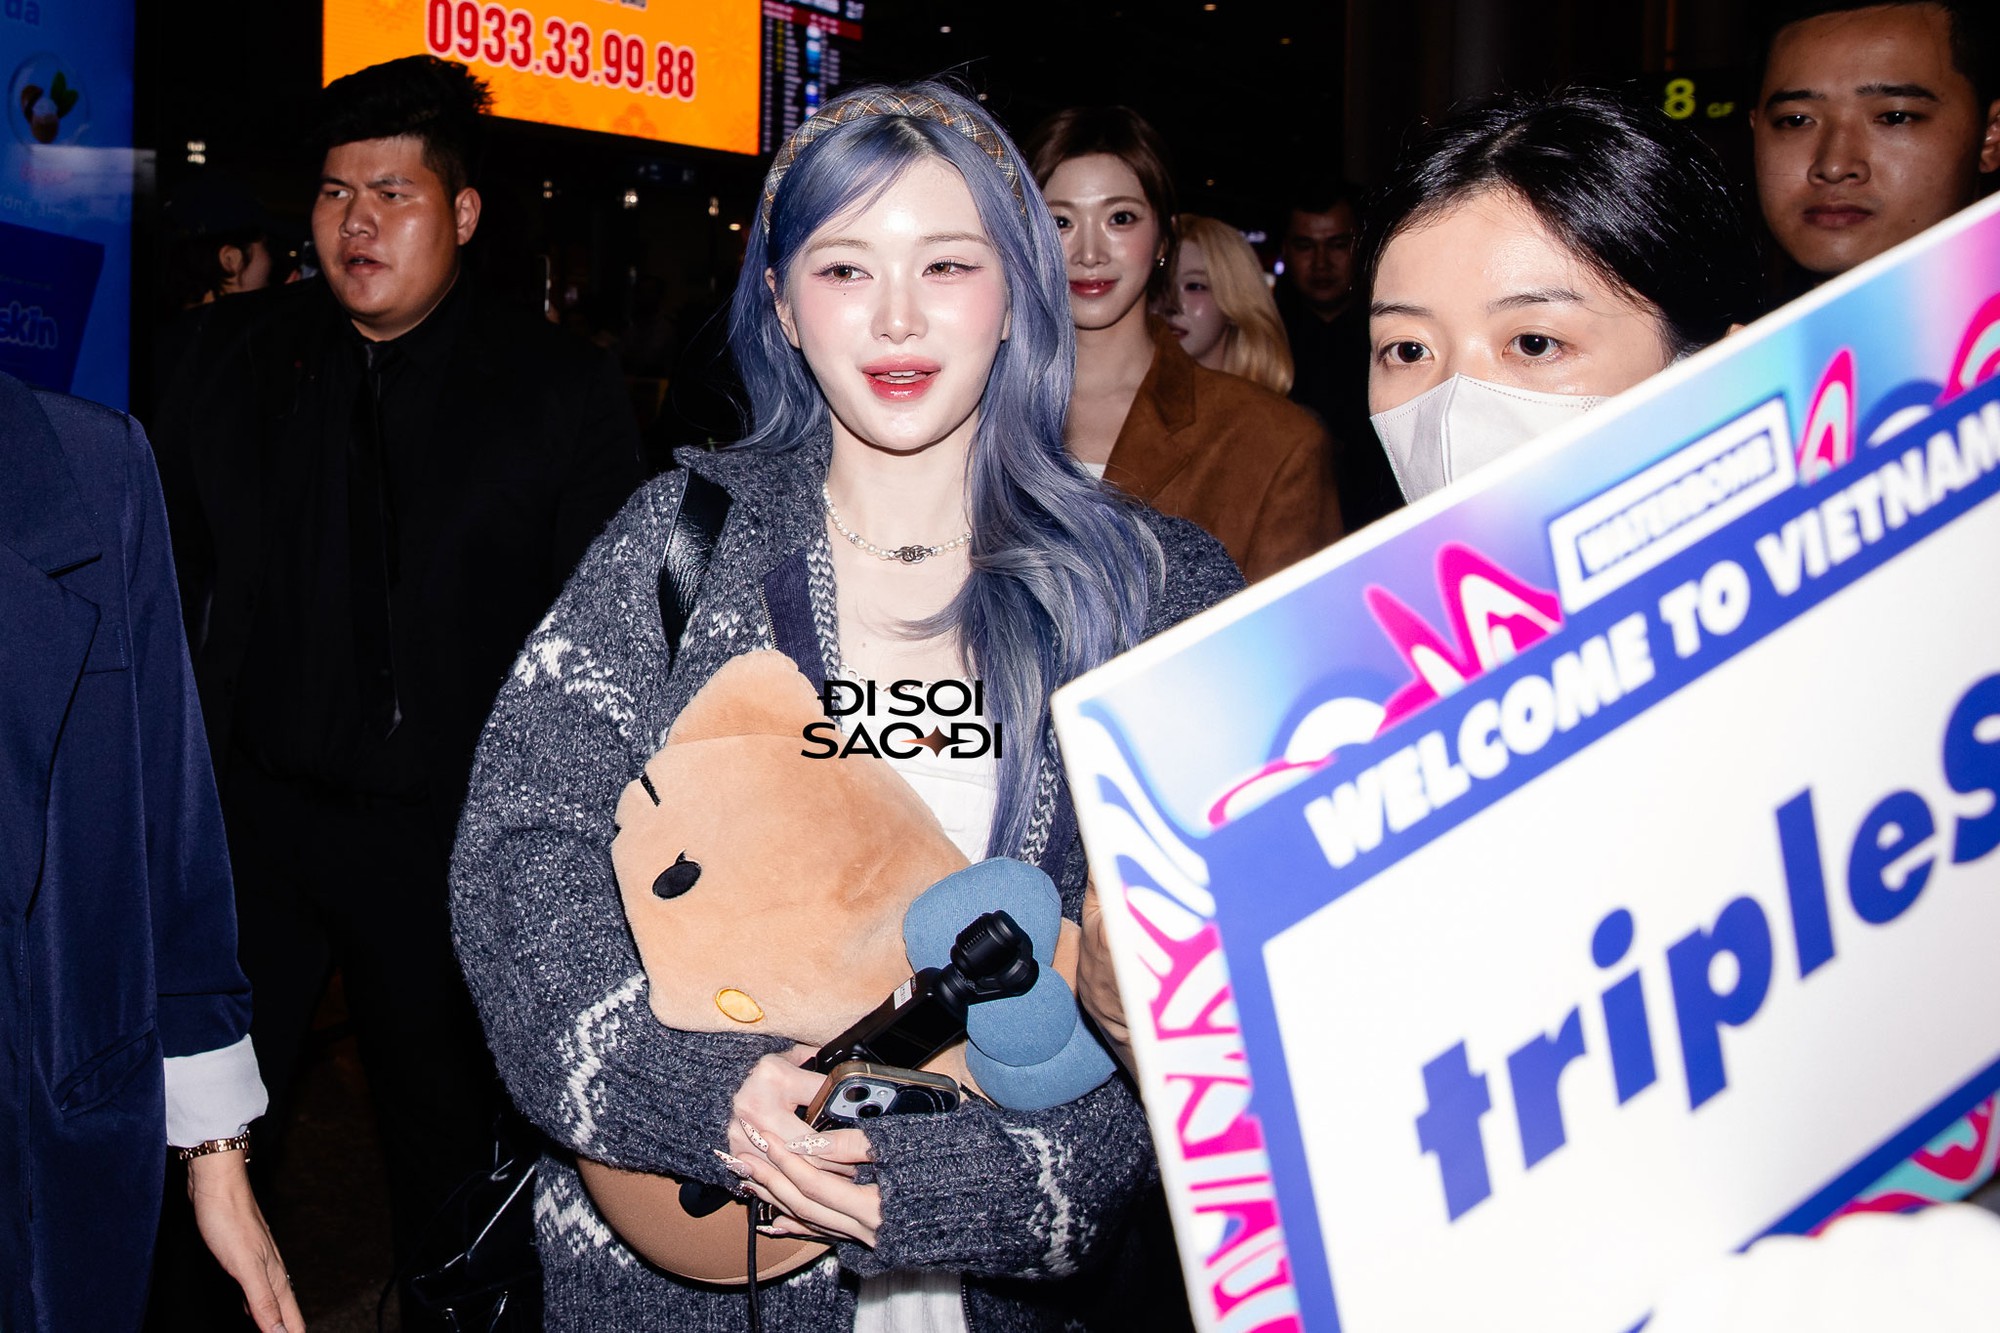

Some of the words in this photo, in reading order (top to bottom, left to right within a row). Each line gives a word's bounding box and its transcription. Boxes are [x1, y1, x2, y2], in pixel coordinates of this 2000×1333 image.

[427, 0, 696, 100] 0933.33.99.88
[1665, 78, 1696, 120] 8
[1304, 612, 1656, 870] WELCOME
[1659, 560, 1751, 659] TO
[1415, 669, 2000, 1225] tripleS
